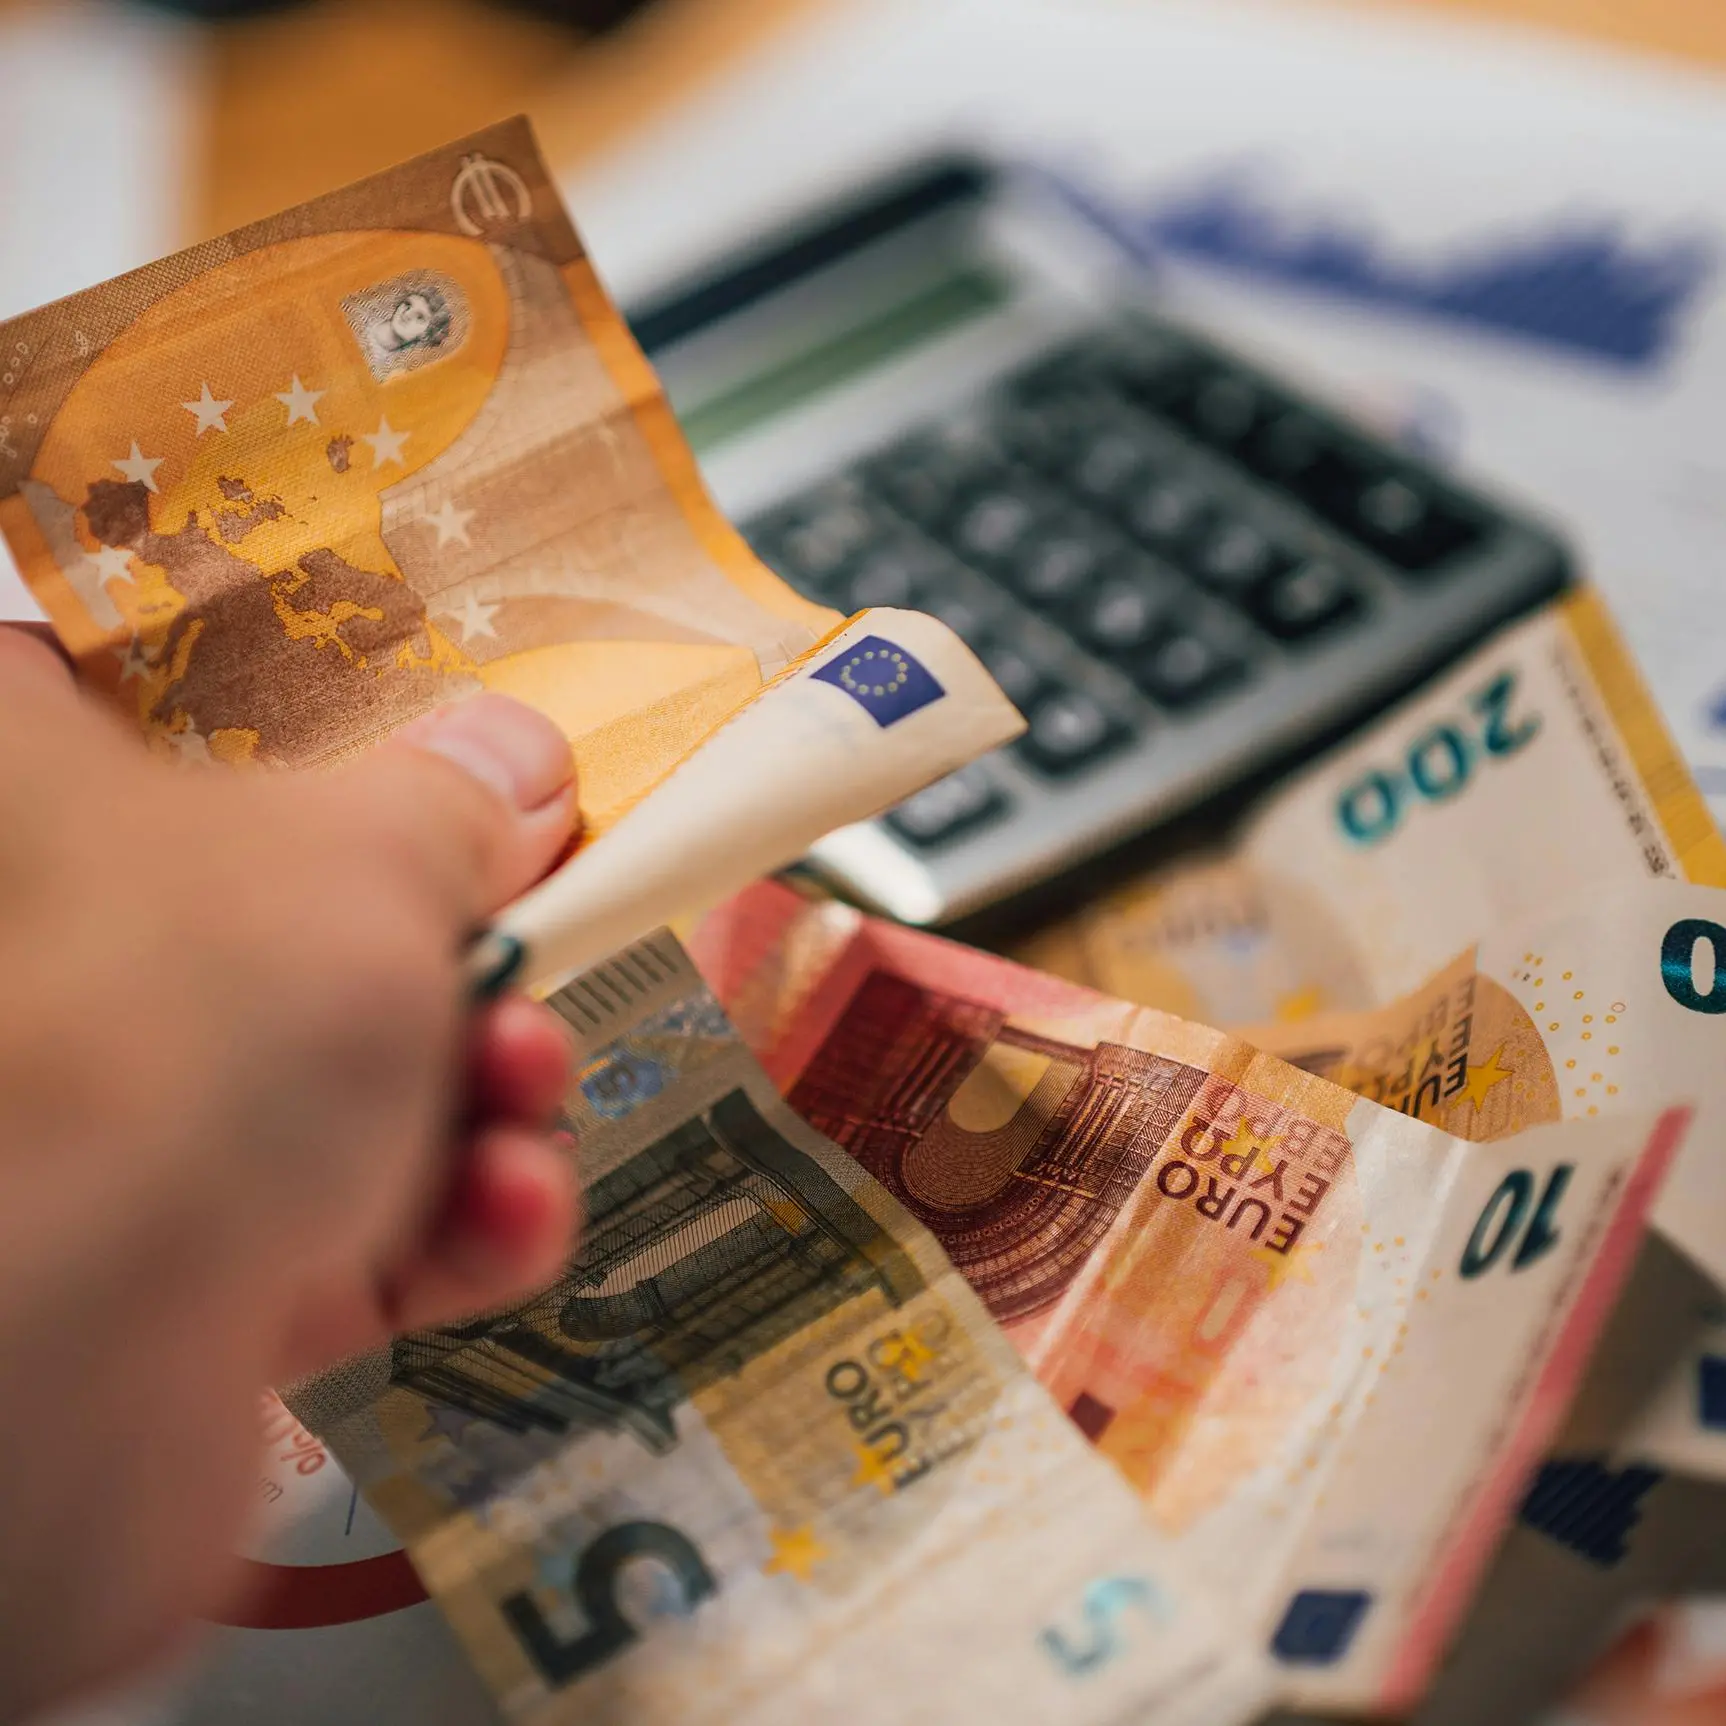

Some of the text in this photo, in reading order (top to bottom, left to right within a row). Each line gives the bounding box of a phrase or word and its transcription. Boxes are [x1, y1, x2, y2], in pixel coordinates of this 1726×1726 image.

[1336, 670, 1544, 846] 200
[1157, 1160, 1306, 1256] EURO
[1459, 1163, 1577, 1280] 10
[500, 1520, 717, 1692] 5
[1035, 1575, 1172, 1680] 5
